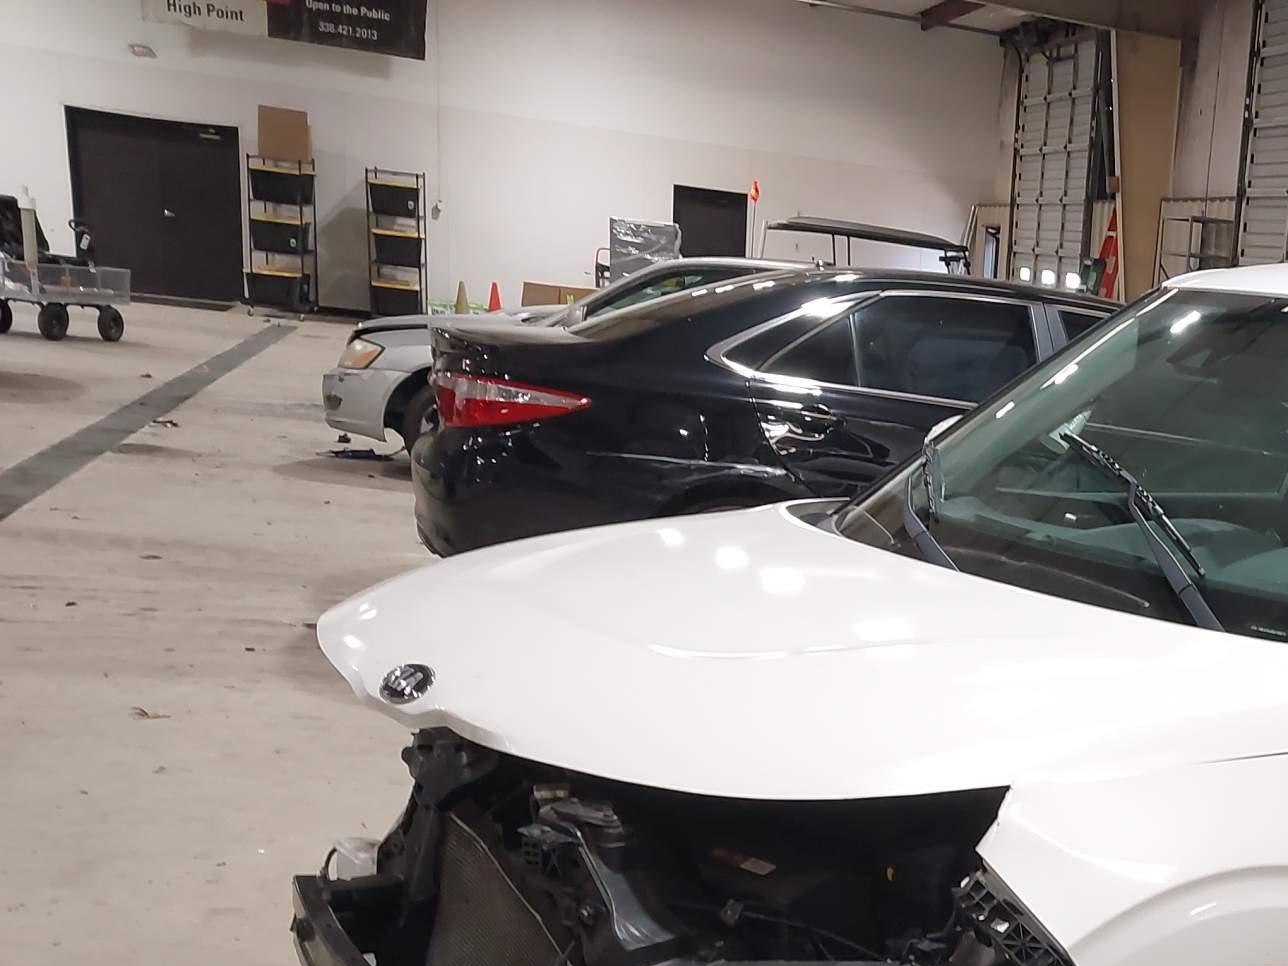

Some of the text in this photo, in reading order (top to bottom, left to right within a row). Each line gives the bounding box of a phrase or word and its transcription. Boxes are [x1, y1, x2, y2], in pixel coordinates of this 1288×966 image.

[167, 0, 243, 21] High Point
[332, 3, 341, 13] to
[343, 4, 359, 15] the
[360, 6, 390, 21] Public
